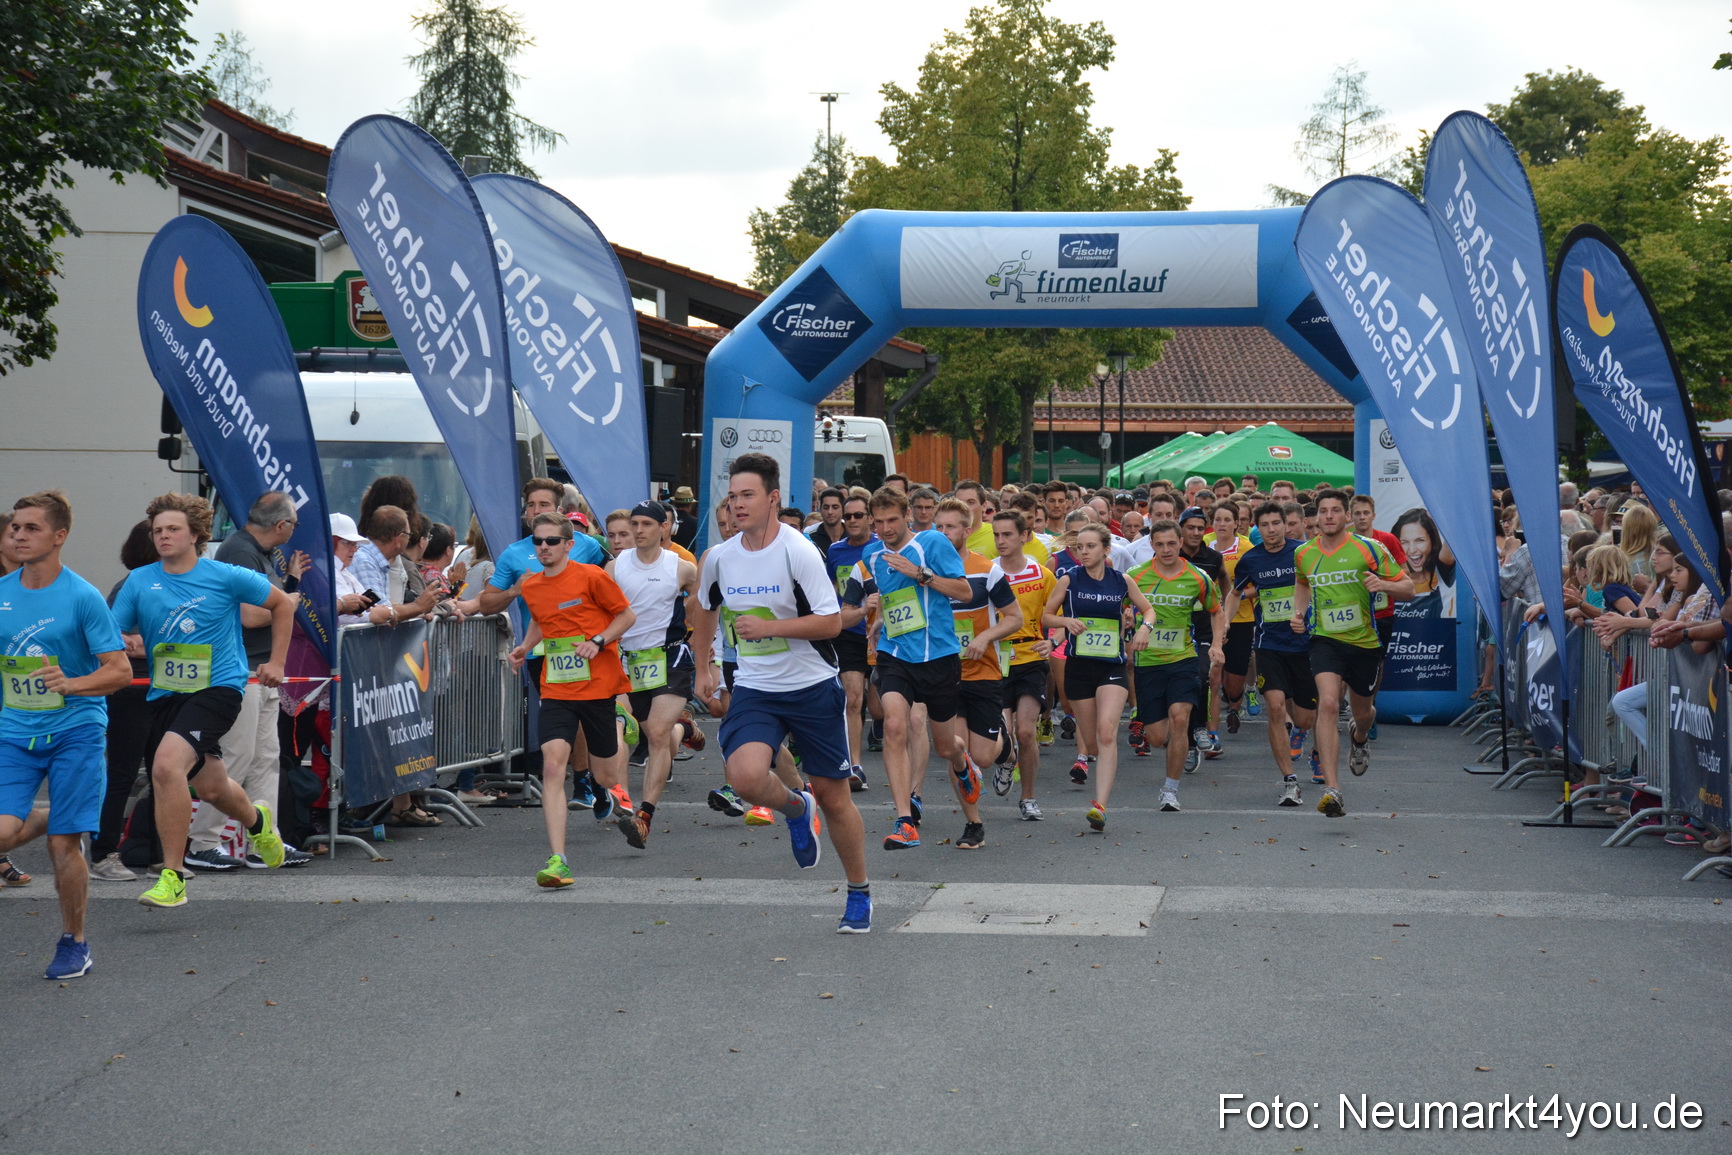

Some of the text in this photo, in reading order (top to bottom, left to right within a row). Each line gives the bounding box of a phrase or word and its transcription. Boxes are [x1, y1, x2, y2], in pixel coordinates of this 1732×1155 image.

[1071, 246, 1115, 256] Fischer
[1037, 268, 1169, 293] firmenlauf
[1037, 294, 1091, 303] neumarkt
[363, 325, 387, 334] 1628
[785, 314, 855, 331] Fischer
[791, 330, 849, 338] AUTOMOBILE
[1246, 465, 1325, 474] Lammsbräu
[1259, 570, 1277, 579] EURO
[727, 584, 780, 595] DELPHI
[1017, 582, 1045, 595] BÖGL
[1077, 591, 1122, 602] EURO POLES
[170, 601, 192, 617] Schick
[191, 595, 207, 605] Bau
[1268, 599, 1292, 613] 374
[888, 605, 914, 625] 522
[1328, 608, 1355, 623] 145
[12, 623, 37, 643] Schick
[38, 616, 55, 627] Bau
[1155, 630, 1179, 642] 147
[1085, 632, 1112, 647] 372
[1386, 641, 1444, 654] Fischer
[550, 655, 584, 670] 1028
[164, 660, 198, 680] 813
[633, 664, 659, 680] 972
[11, 677, 48, 696] 819
